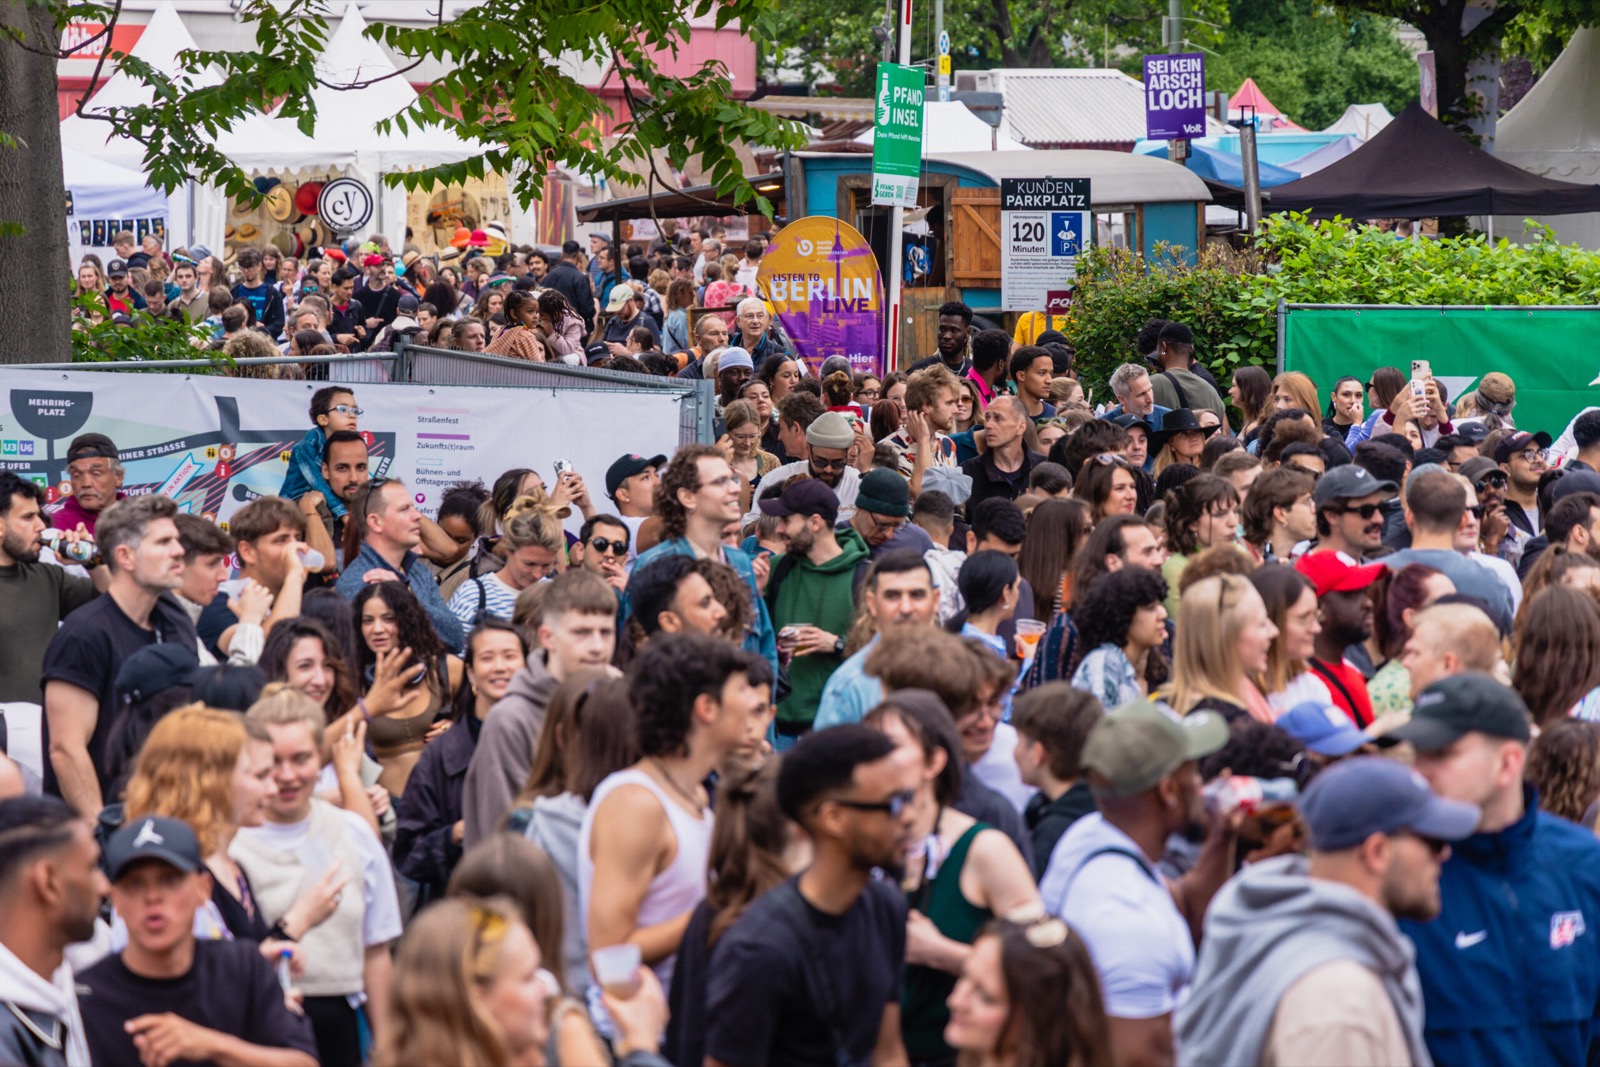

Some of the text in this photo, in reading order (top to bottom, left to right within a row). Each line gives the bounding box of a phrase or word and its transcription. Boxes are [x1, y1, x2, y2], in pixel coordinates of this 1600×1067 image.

[1148, 58, 1201, 74] SEI KEIN
[1149, 72, 1202, 90] ARSCH
[893, 86, 923, 107] PFAND
[1149, 88, 1202, 111] LOCH
[892, 107, 919, 128] INSEL
[1183, 123, 1203, 134] Volt
[888, 132, 901, 140] Pfand
[1017, 182, 1074, 194] KUNDEN
[1006, 195, 1085, 207] PARKPLATZ
[1012, 222, 1045, 242] 120
[1012, 245, 1045, 253] Minuten
[1063, 242, 1070, 252] P
[772, 273, 820, 282] LISTEN TO
[770, 277, 872, 301] BERLIN
[822, 298, 870, 313] LIVE
[1048, 298, 1075, 308] PO
[849, 352, 874, 363] Hier
[28, 398, 75, 406] MEHRING-
[418, 416, 459, 424] Straßenfest
[4, 443, 17, 452] U3
[20, 444, 33, 452] U6
[146, 440, 187, 456] STRASSE
[416, 442, 474, 450] Zukunfts(t)raum
[174, 464, 192, 486] AKTION
[130, 488, 152, 496] UFER
